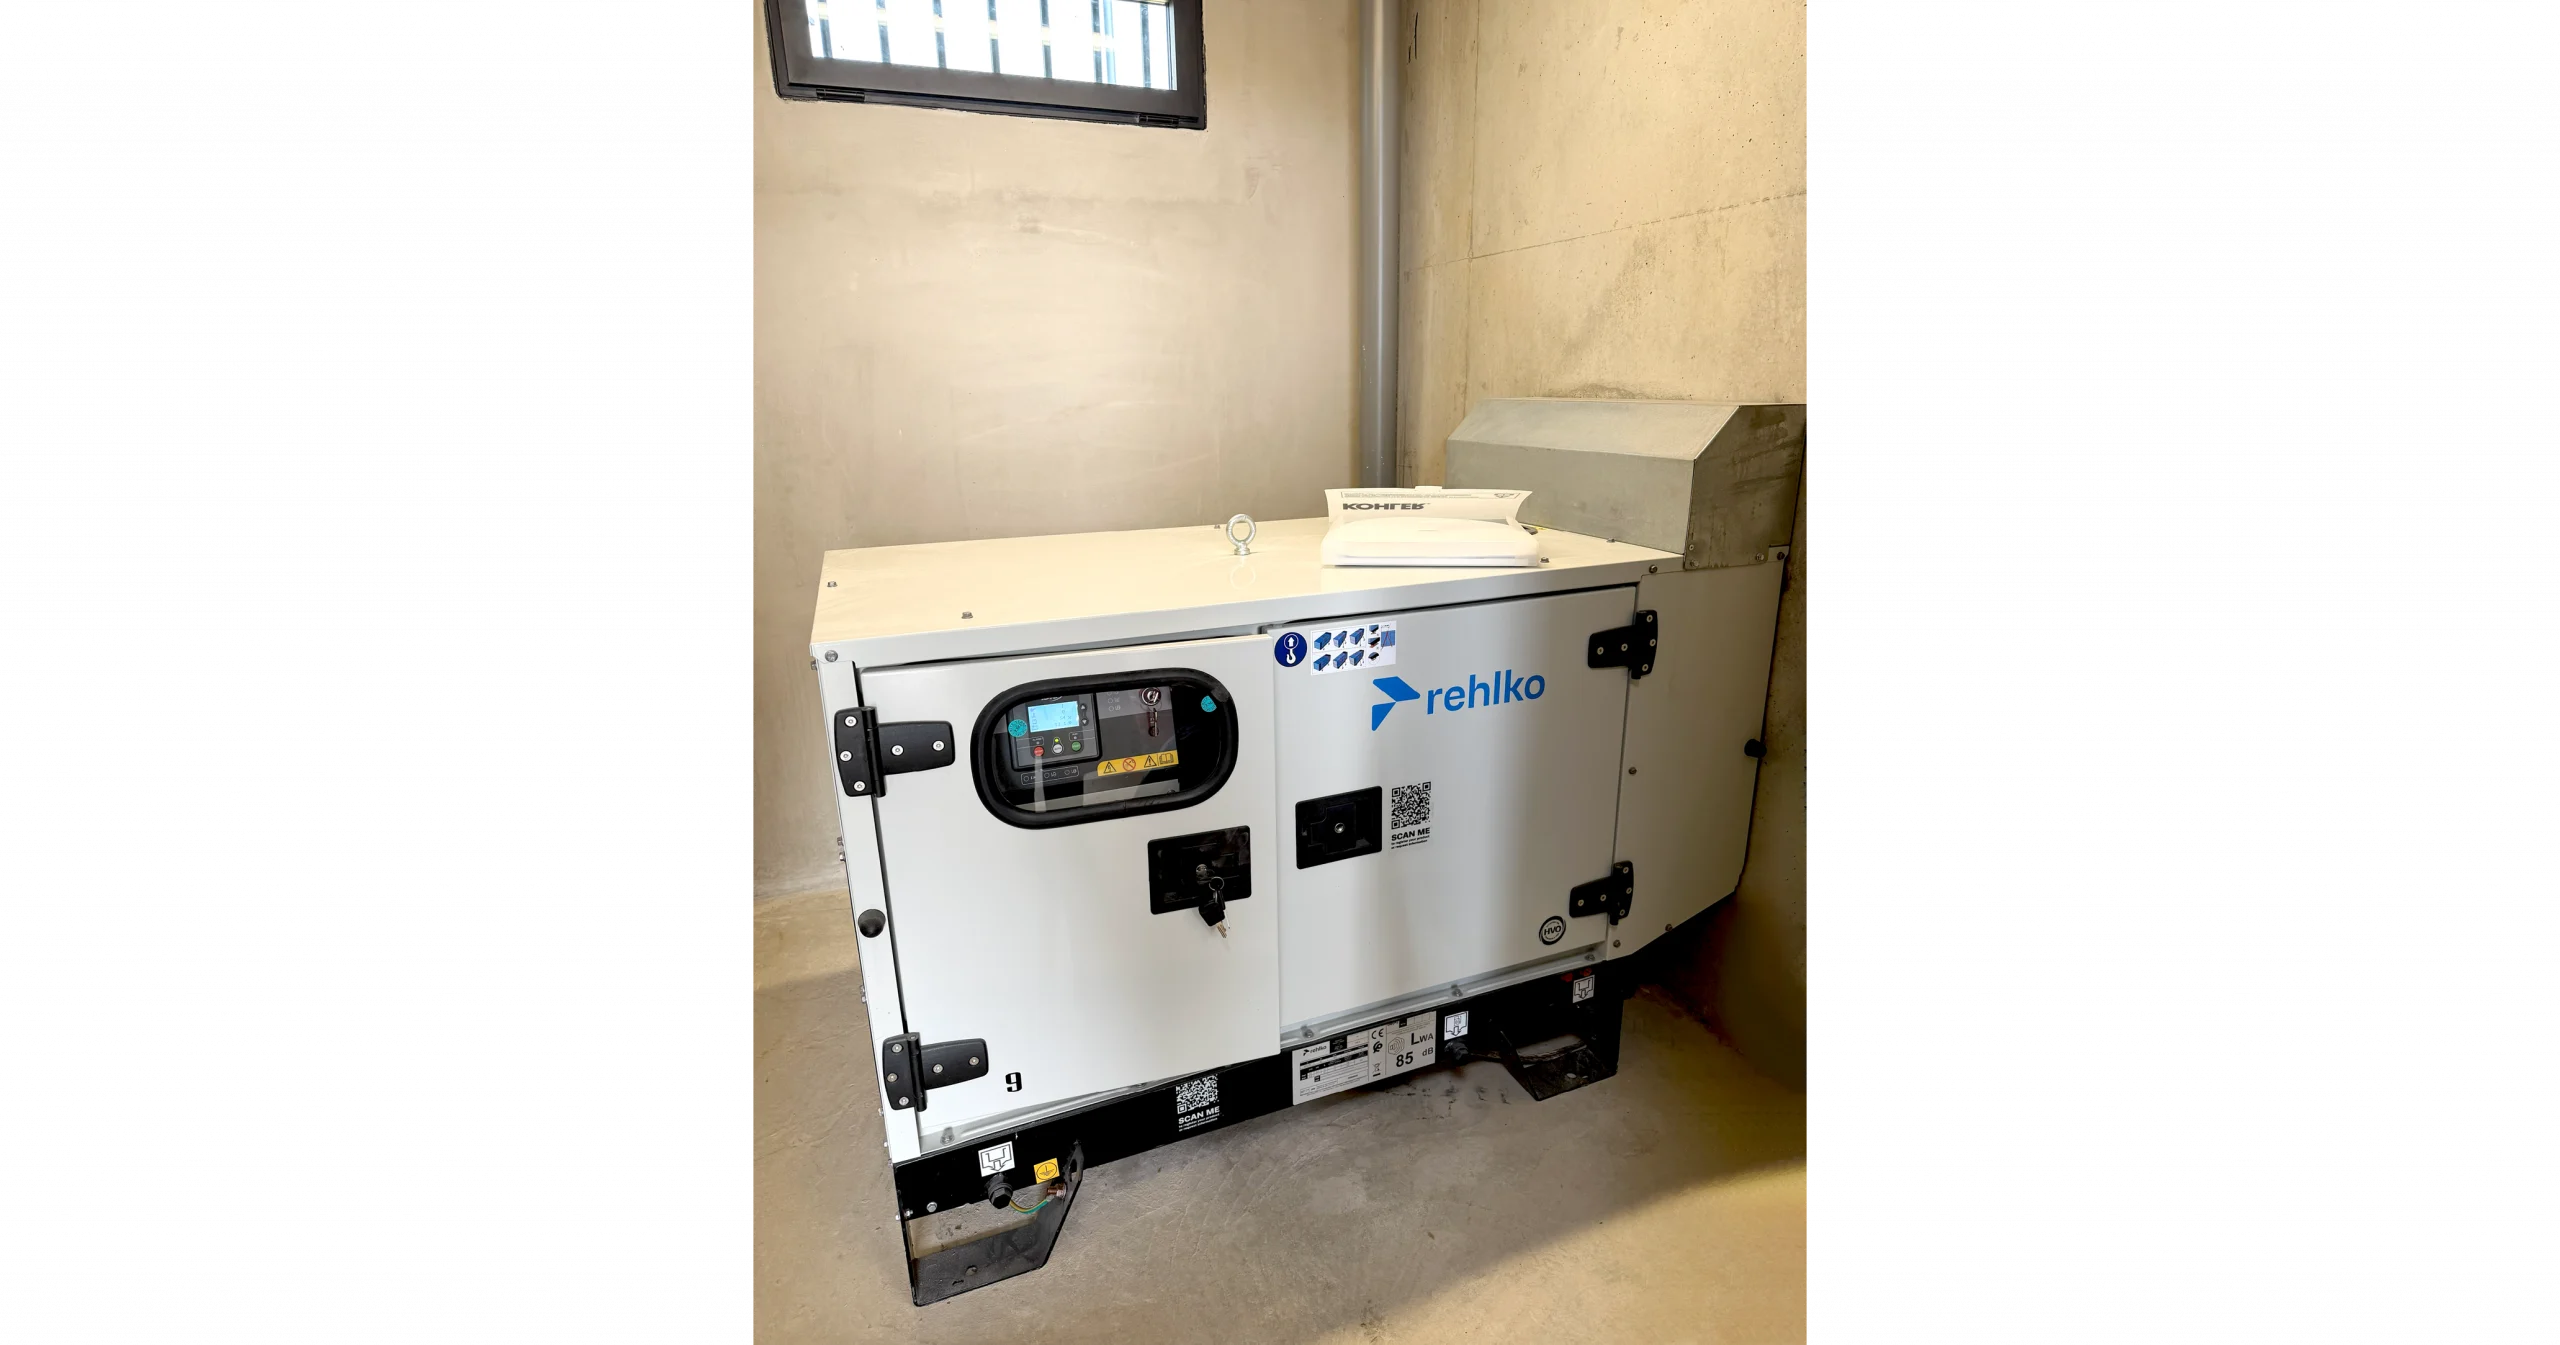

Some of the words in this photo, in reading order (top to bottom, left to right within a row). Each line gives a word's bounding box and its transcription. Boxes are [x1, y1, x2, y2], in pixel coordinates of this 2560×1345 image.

[1427, 669, 1546, 715] rehlko
[1391, 830, 1415, 841] SCAN
[1418, 827, 1430, 836] ME
[1543, 925, 1562, 936] HVO
[1309, 1045, 1327, 1054] rehlko
[1396, 1051, 1414, 1067] 85
[1422, 1047, 1434, 1056] dB
[1005, 1071, 1023, 1093] 9
[1178, 1111, 1204, 1125] SCAN
[1206, 1106, 1220, 1115] ME
